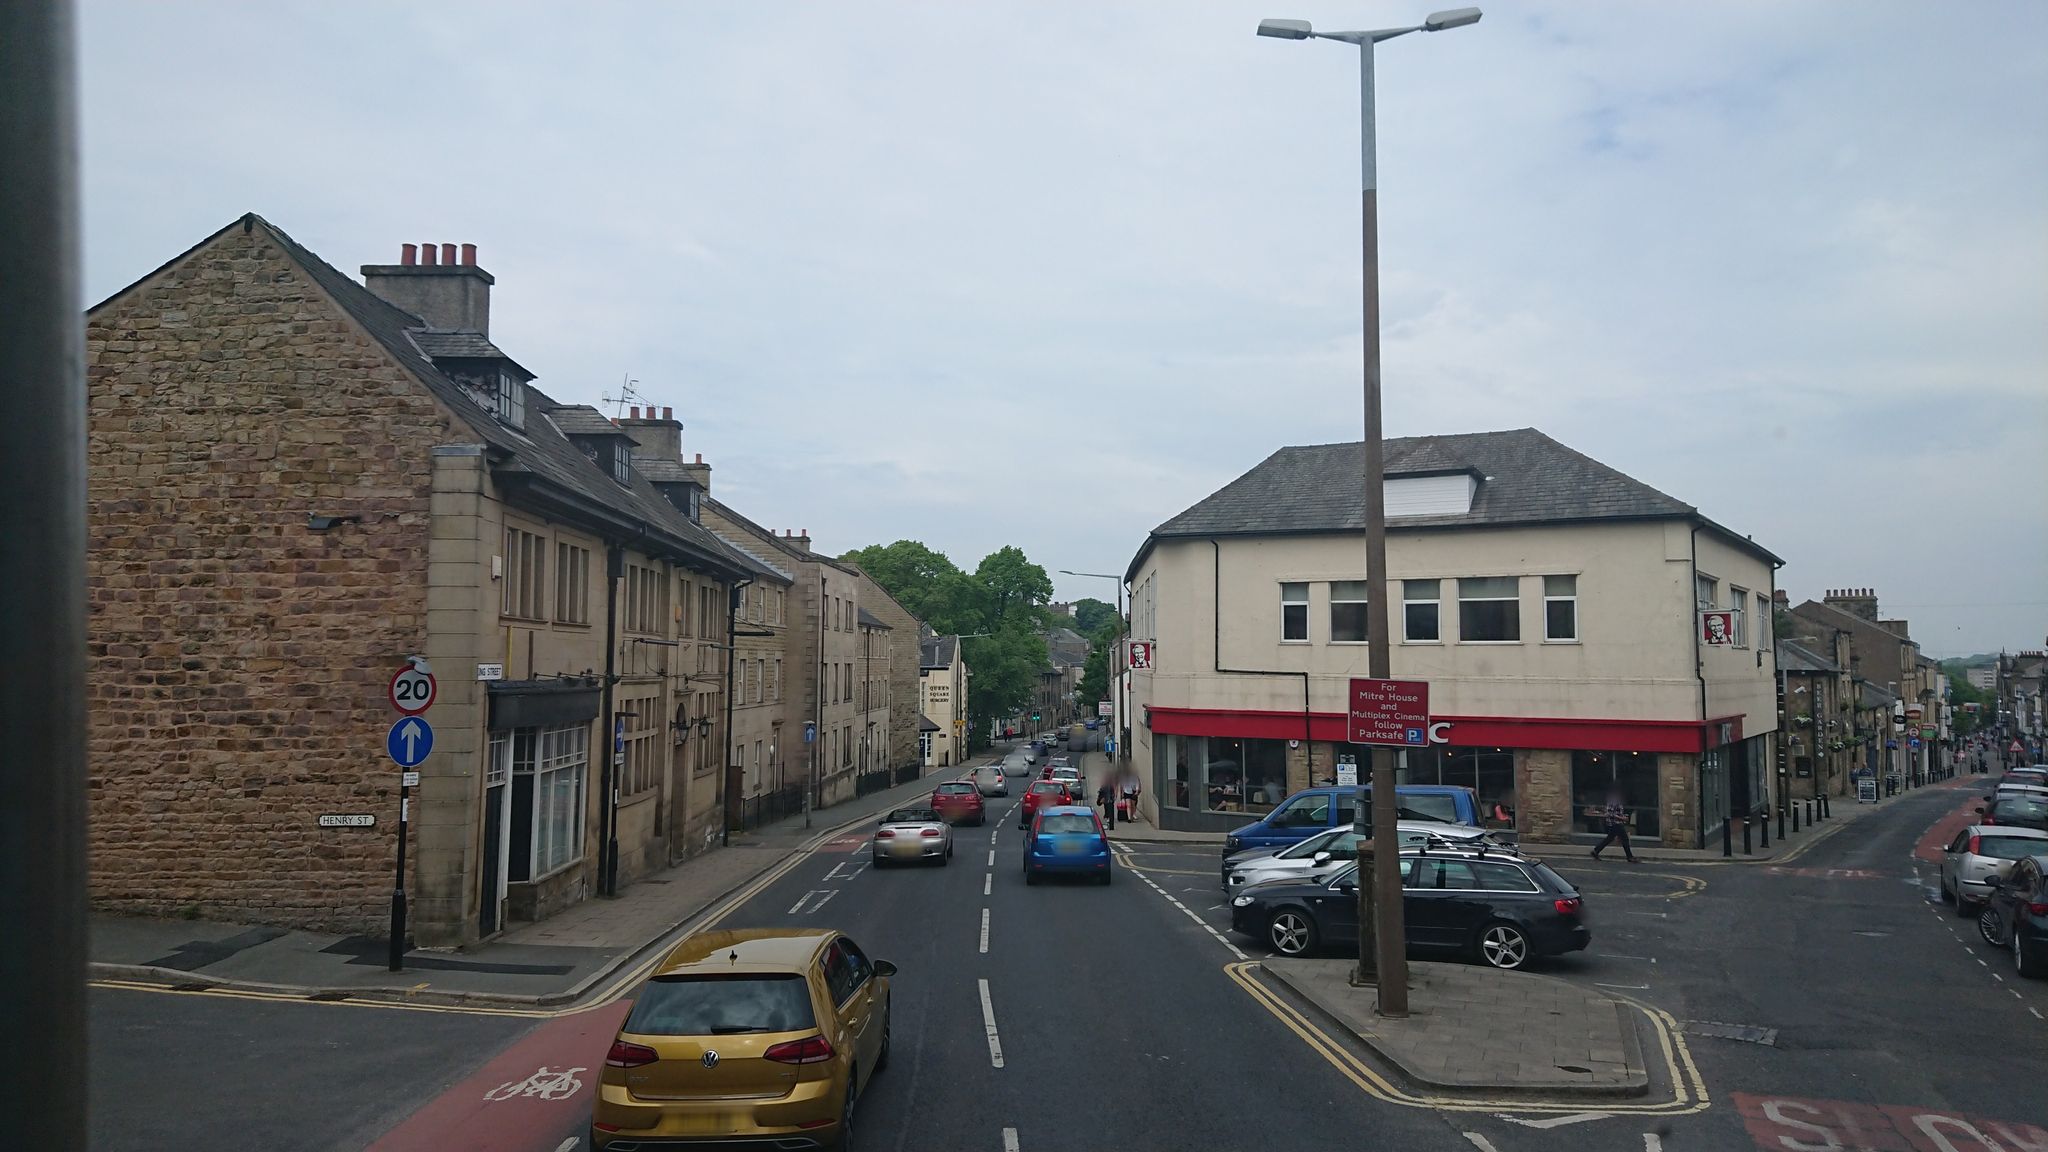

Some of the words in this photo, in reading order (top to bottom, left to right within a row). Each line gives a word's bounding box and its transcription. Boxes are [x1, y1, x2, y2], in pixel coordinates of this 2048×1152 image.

[396, 679, 429, 700] 20
[1381, 682, 1397, 691] For
[1359, 691, 1385, 701] Mitre
[1388, 693, 1418, 702] House
[1380, 702, 1397, 711] and
[1352, 710, 1391, 720] Multiplex
[1394, 712, 1425, 721] Cinema
[1374, 720, 1403, 730] follow
[1359, 728, 1404, 740] Parksafe
[322, 816, 354, 825] HENRY
[357, 816, 369, 825] ST
